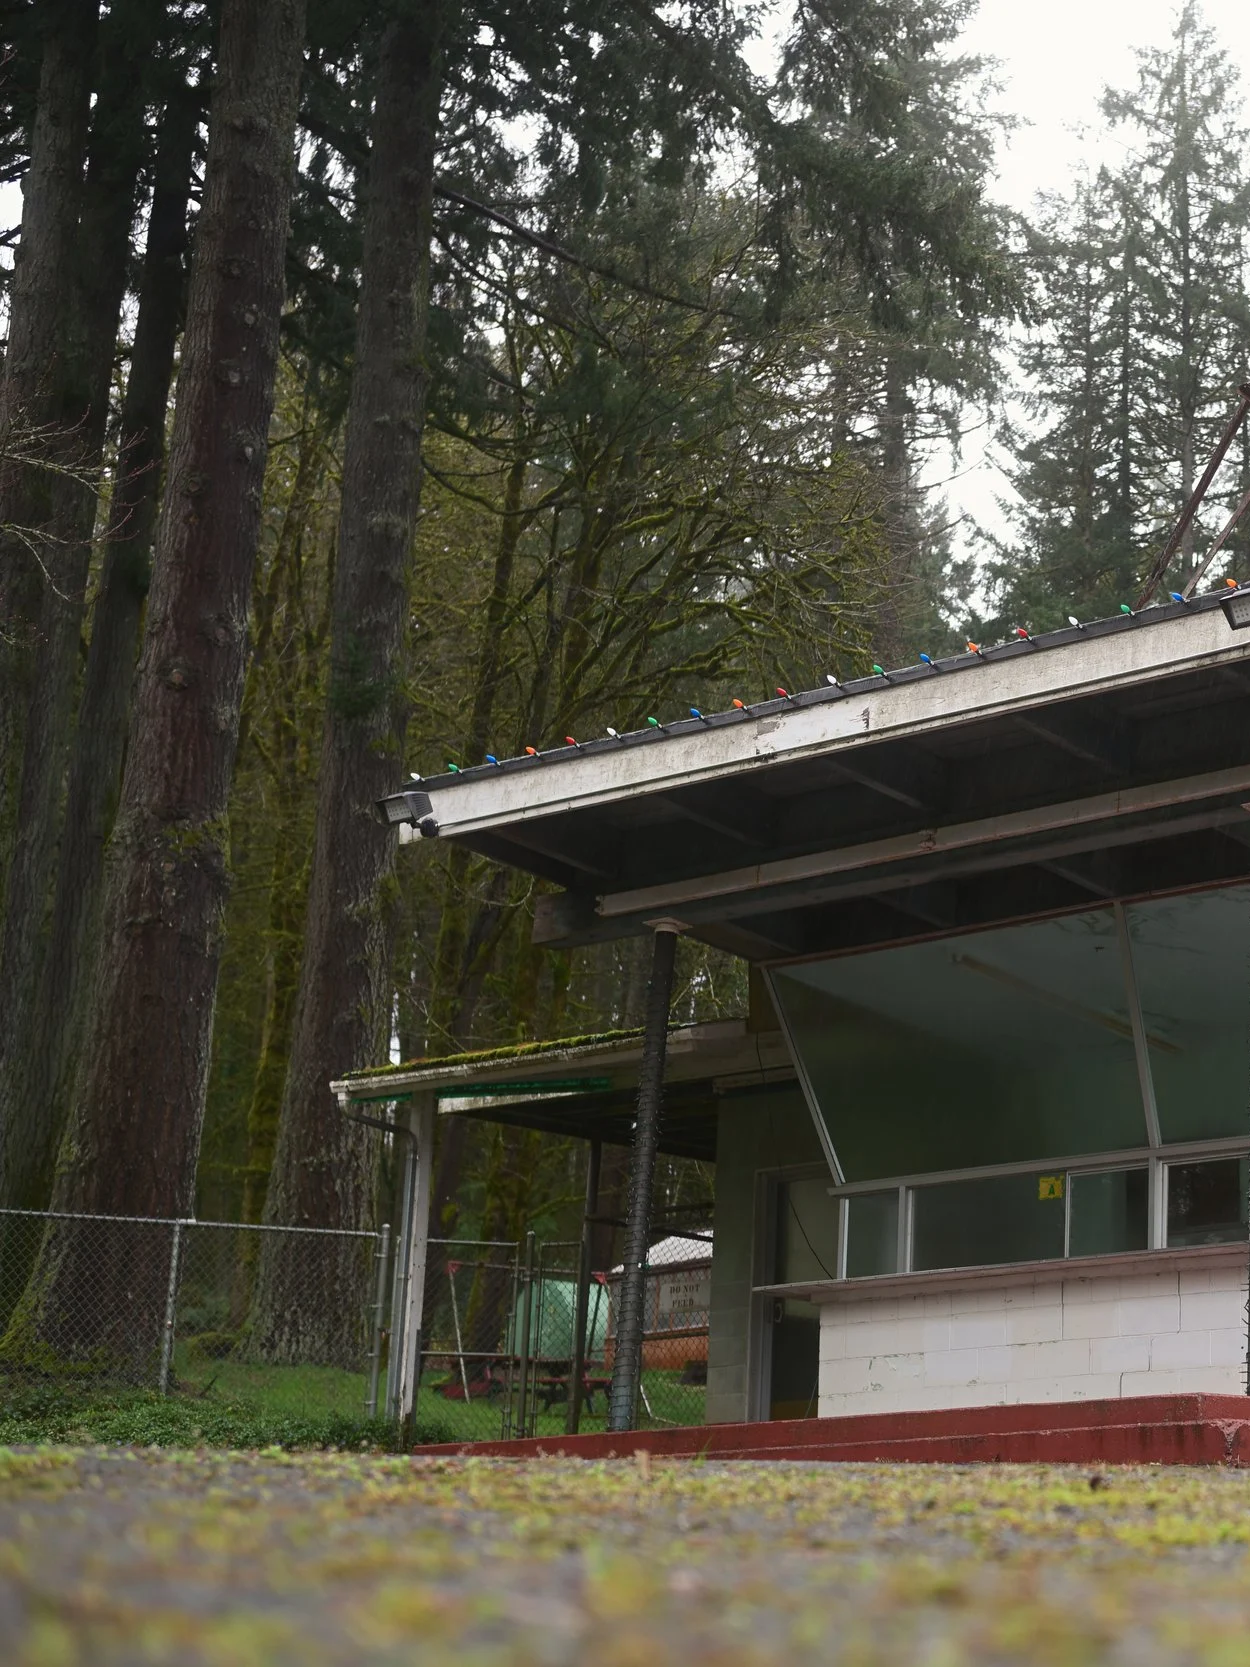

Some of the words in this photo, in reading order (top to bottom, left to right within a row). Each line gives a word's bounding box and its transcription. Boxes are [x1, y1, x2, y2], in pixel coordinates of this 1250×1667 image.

[669, 1286, 681, 1294] DO
[683, 1284, 700, 1293] NOT
[672, 1298, 694, 1308] FEED
